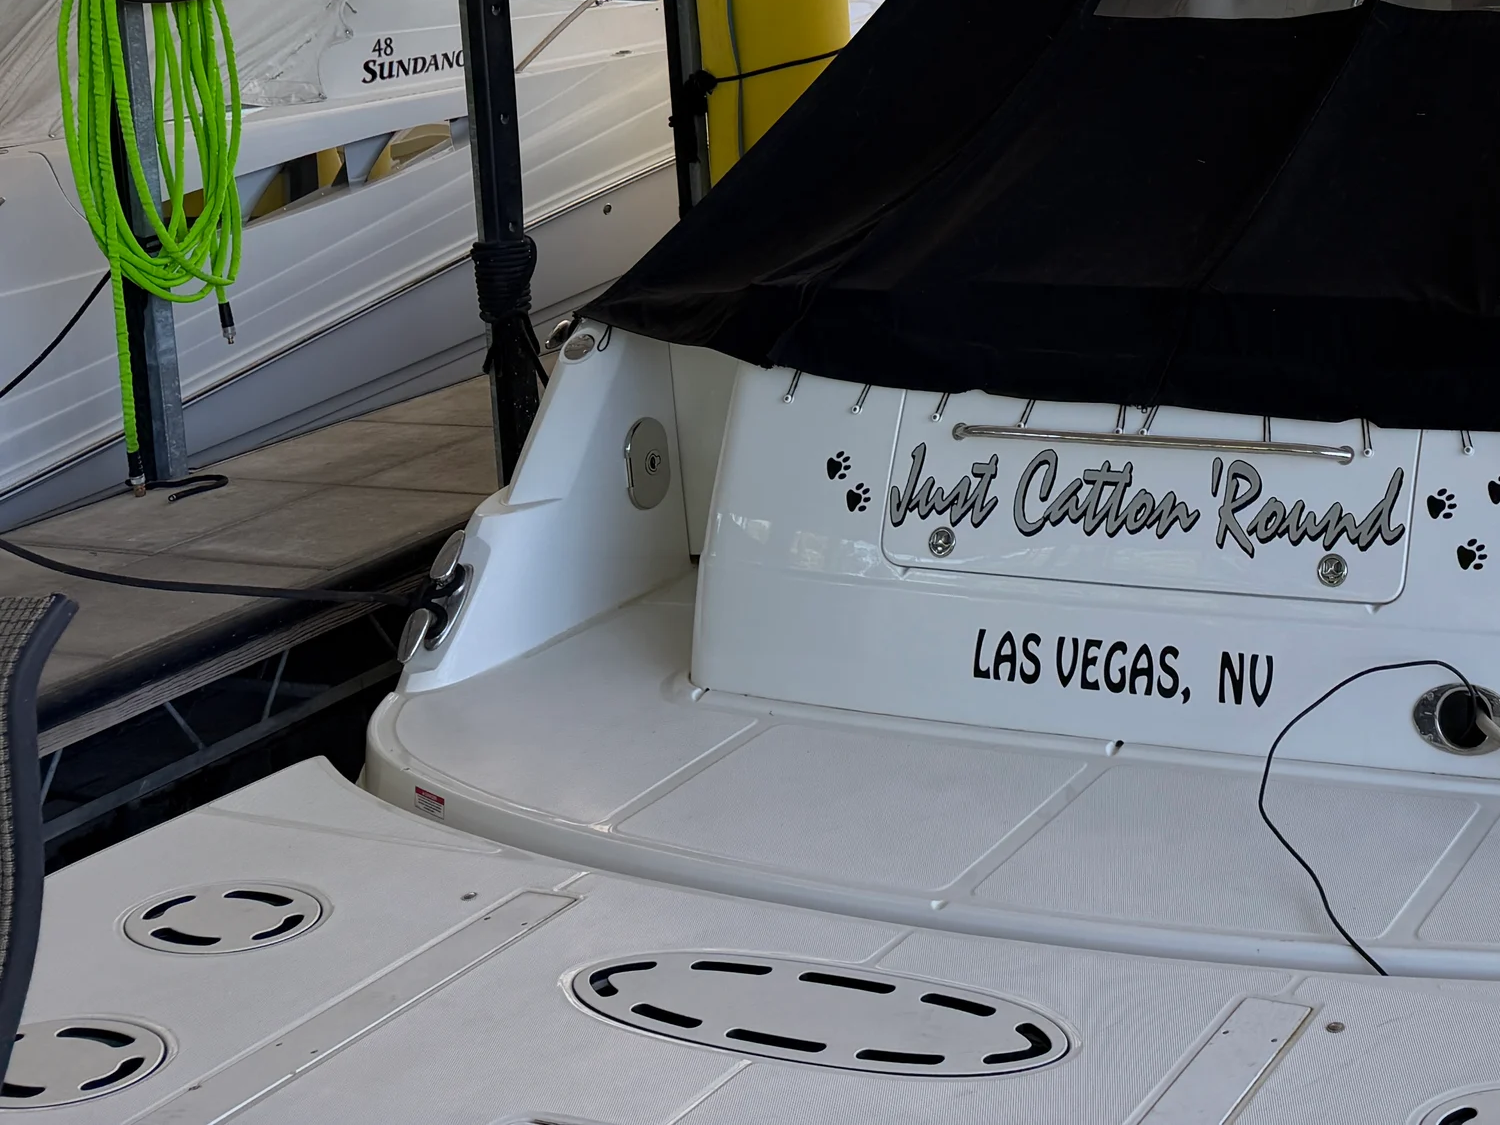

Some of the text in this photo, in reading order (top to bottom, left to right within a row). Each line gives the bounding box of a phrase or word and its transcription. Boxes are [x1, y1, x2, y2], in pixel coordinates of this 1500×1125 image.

[361, 50, 465, 84] SUNDANC
[372, 37, 394, 57] 48
[890, 442, 1406, 559] Just Catton 'Round
[973, 629, 1274, 708] LAS VEGAS, NV
